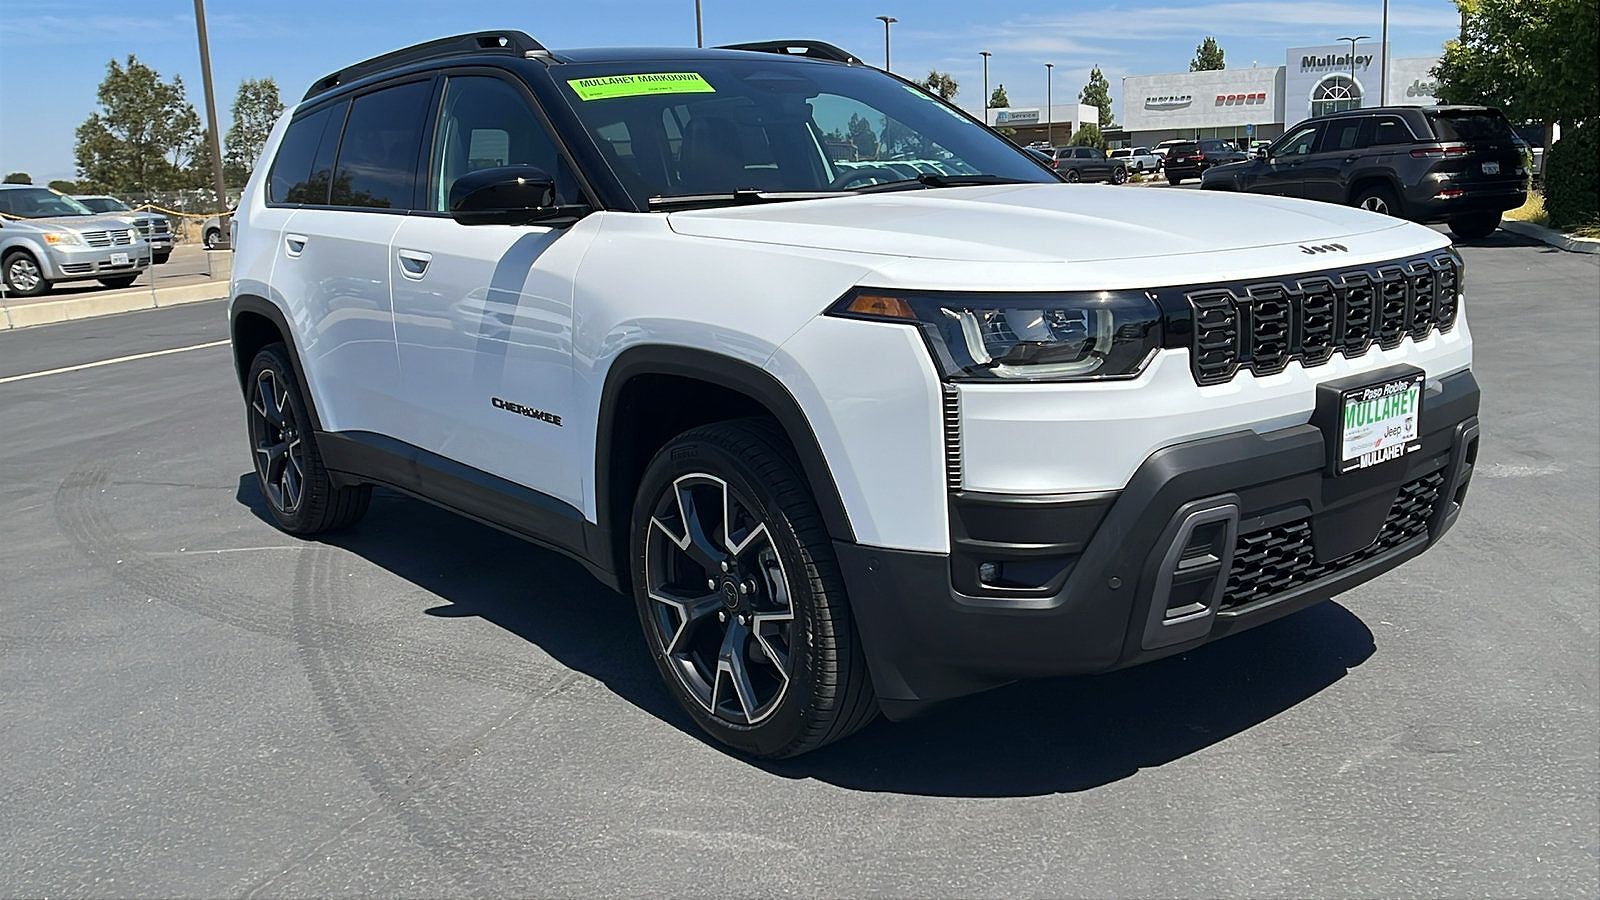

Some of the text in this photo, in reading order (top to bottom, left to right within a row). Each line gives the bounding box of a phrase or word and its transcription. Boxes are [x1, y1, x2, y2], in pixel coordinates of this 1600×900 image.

[1302, 54, 1373, 67] Mullahey
[580, 74, 699, 87] MULLAHEY MARKDOWN
[1215, 93, 1266, 105] DODGE
[1298, 243, 1348, 255] Jeep
[1363, 387, 1383, 400] Paso
[1383, 381, 1408, 395] Robles
[491, 397, 563, 427] CHEROKEE
[1345, 388, 1417, 429] MULLAHEY
[1384, 425, 1401, 438] Jeep
[1360, 442, 1405, 468] MULLAHEY
